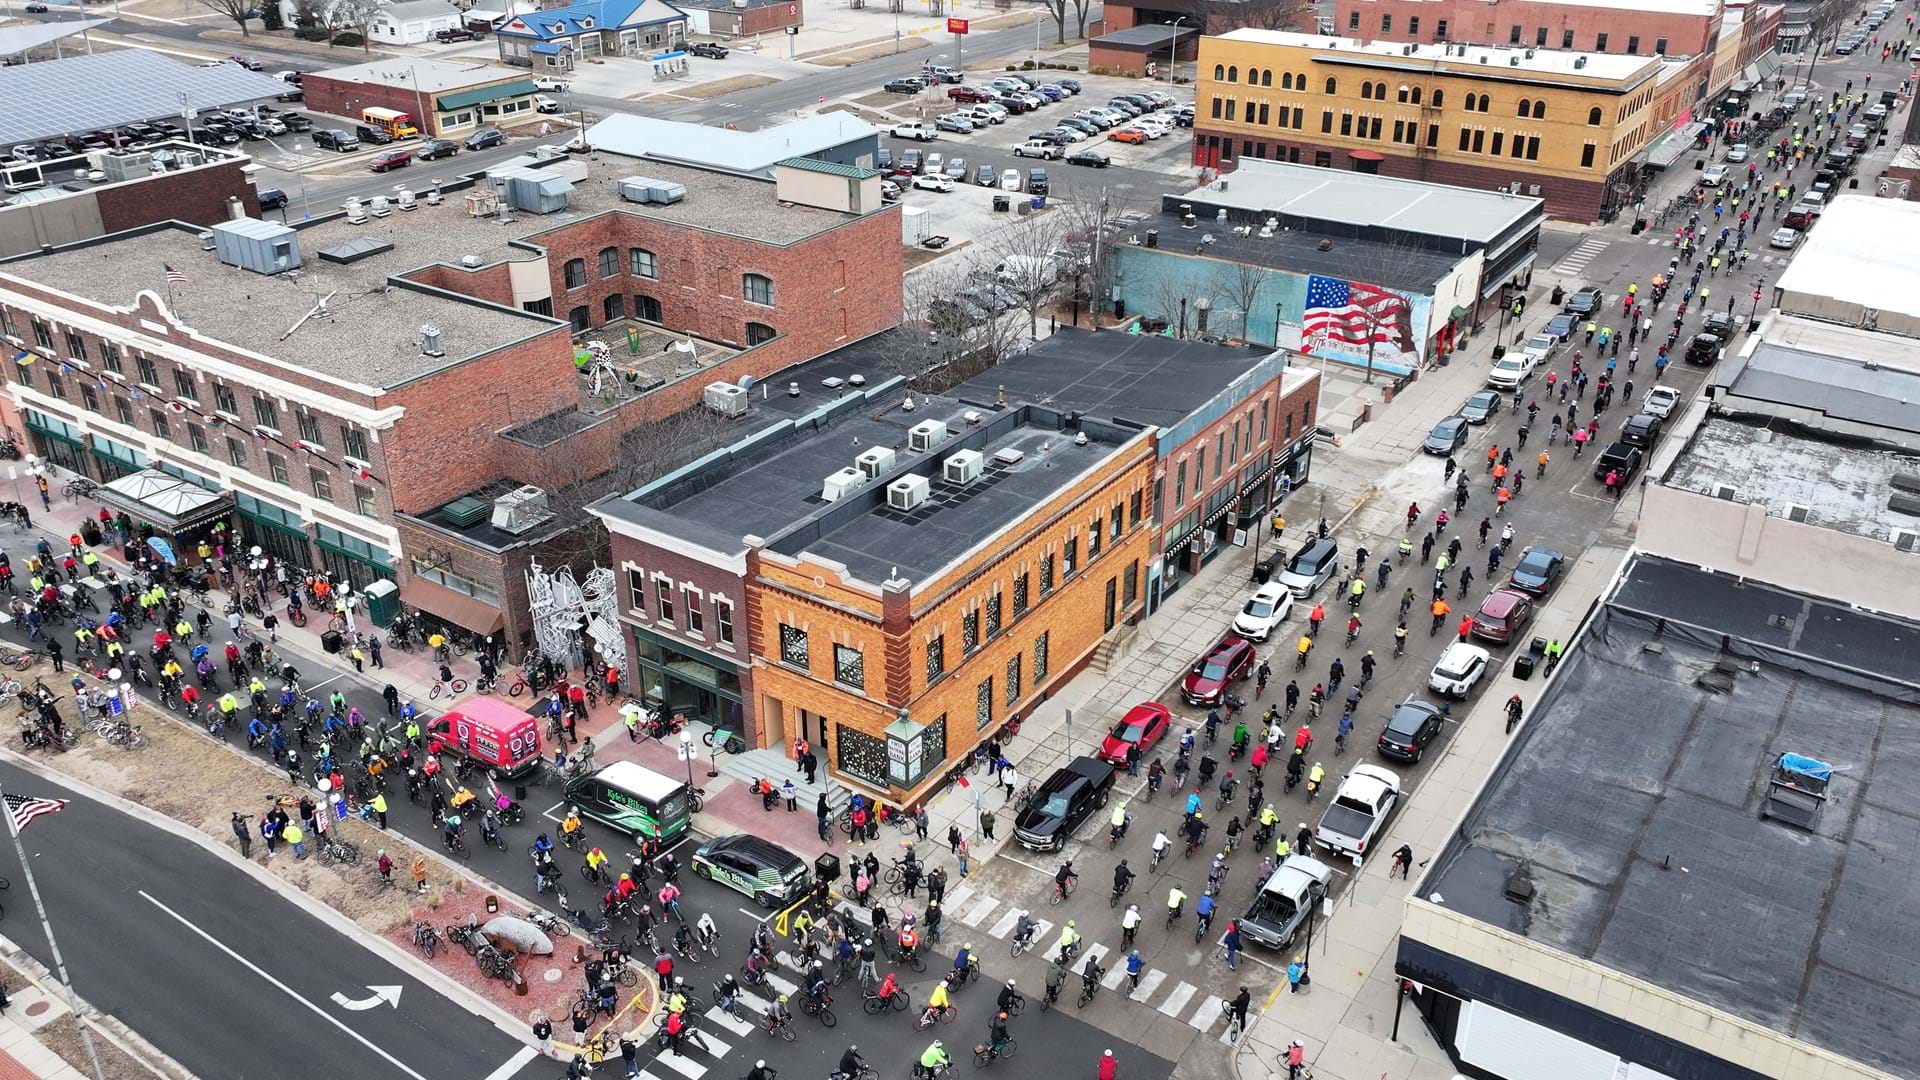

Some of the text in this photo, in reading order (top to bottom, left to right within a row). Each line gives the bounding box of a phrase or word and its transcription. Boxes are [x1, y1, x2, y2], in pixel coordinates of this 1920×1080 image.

[889, 750, 905, 762] BANK
[607, 788, 626, 803] Kyle's
[627, 797, 648, 814] Bikes
[731, 872, 754, 891] Bikes
